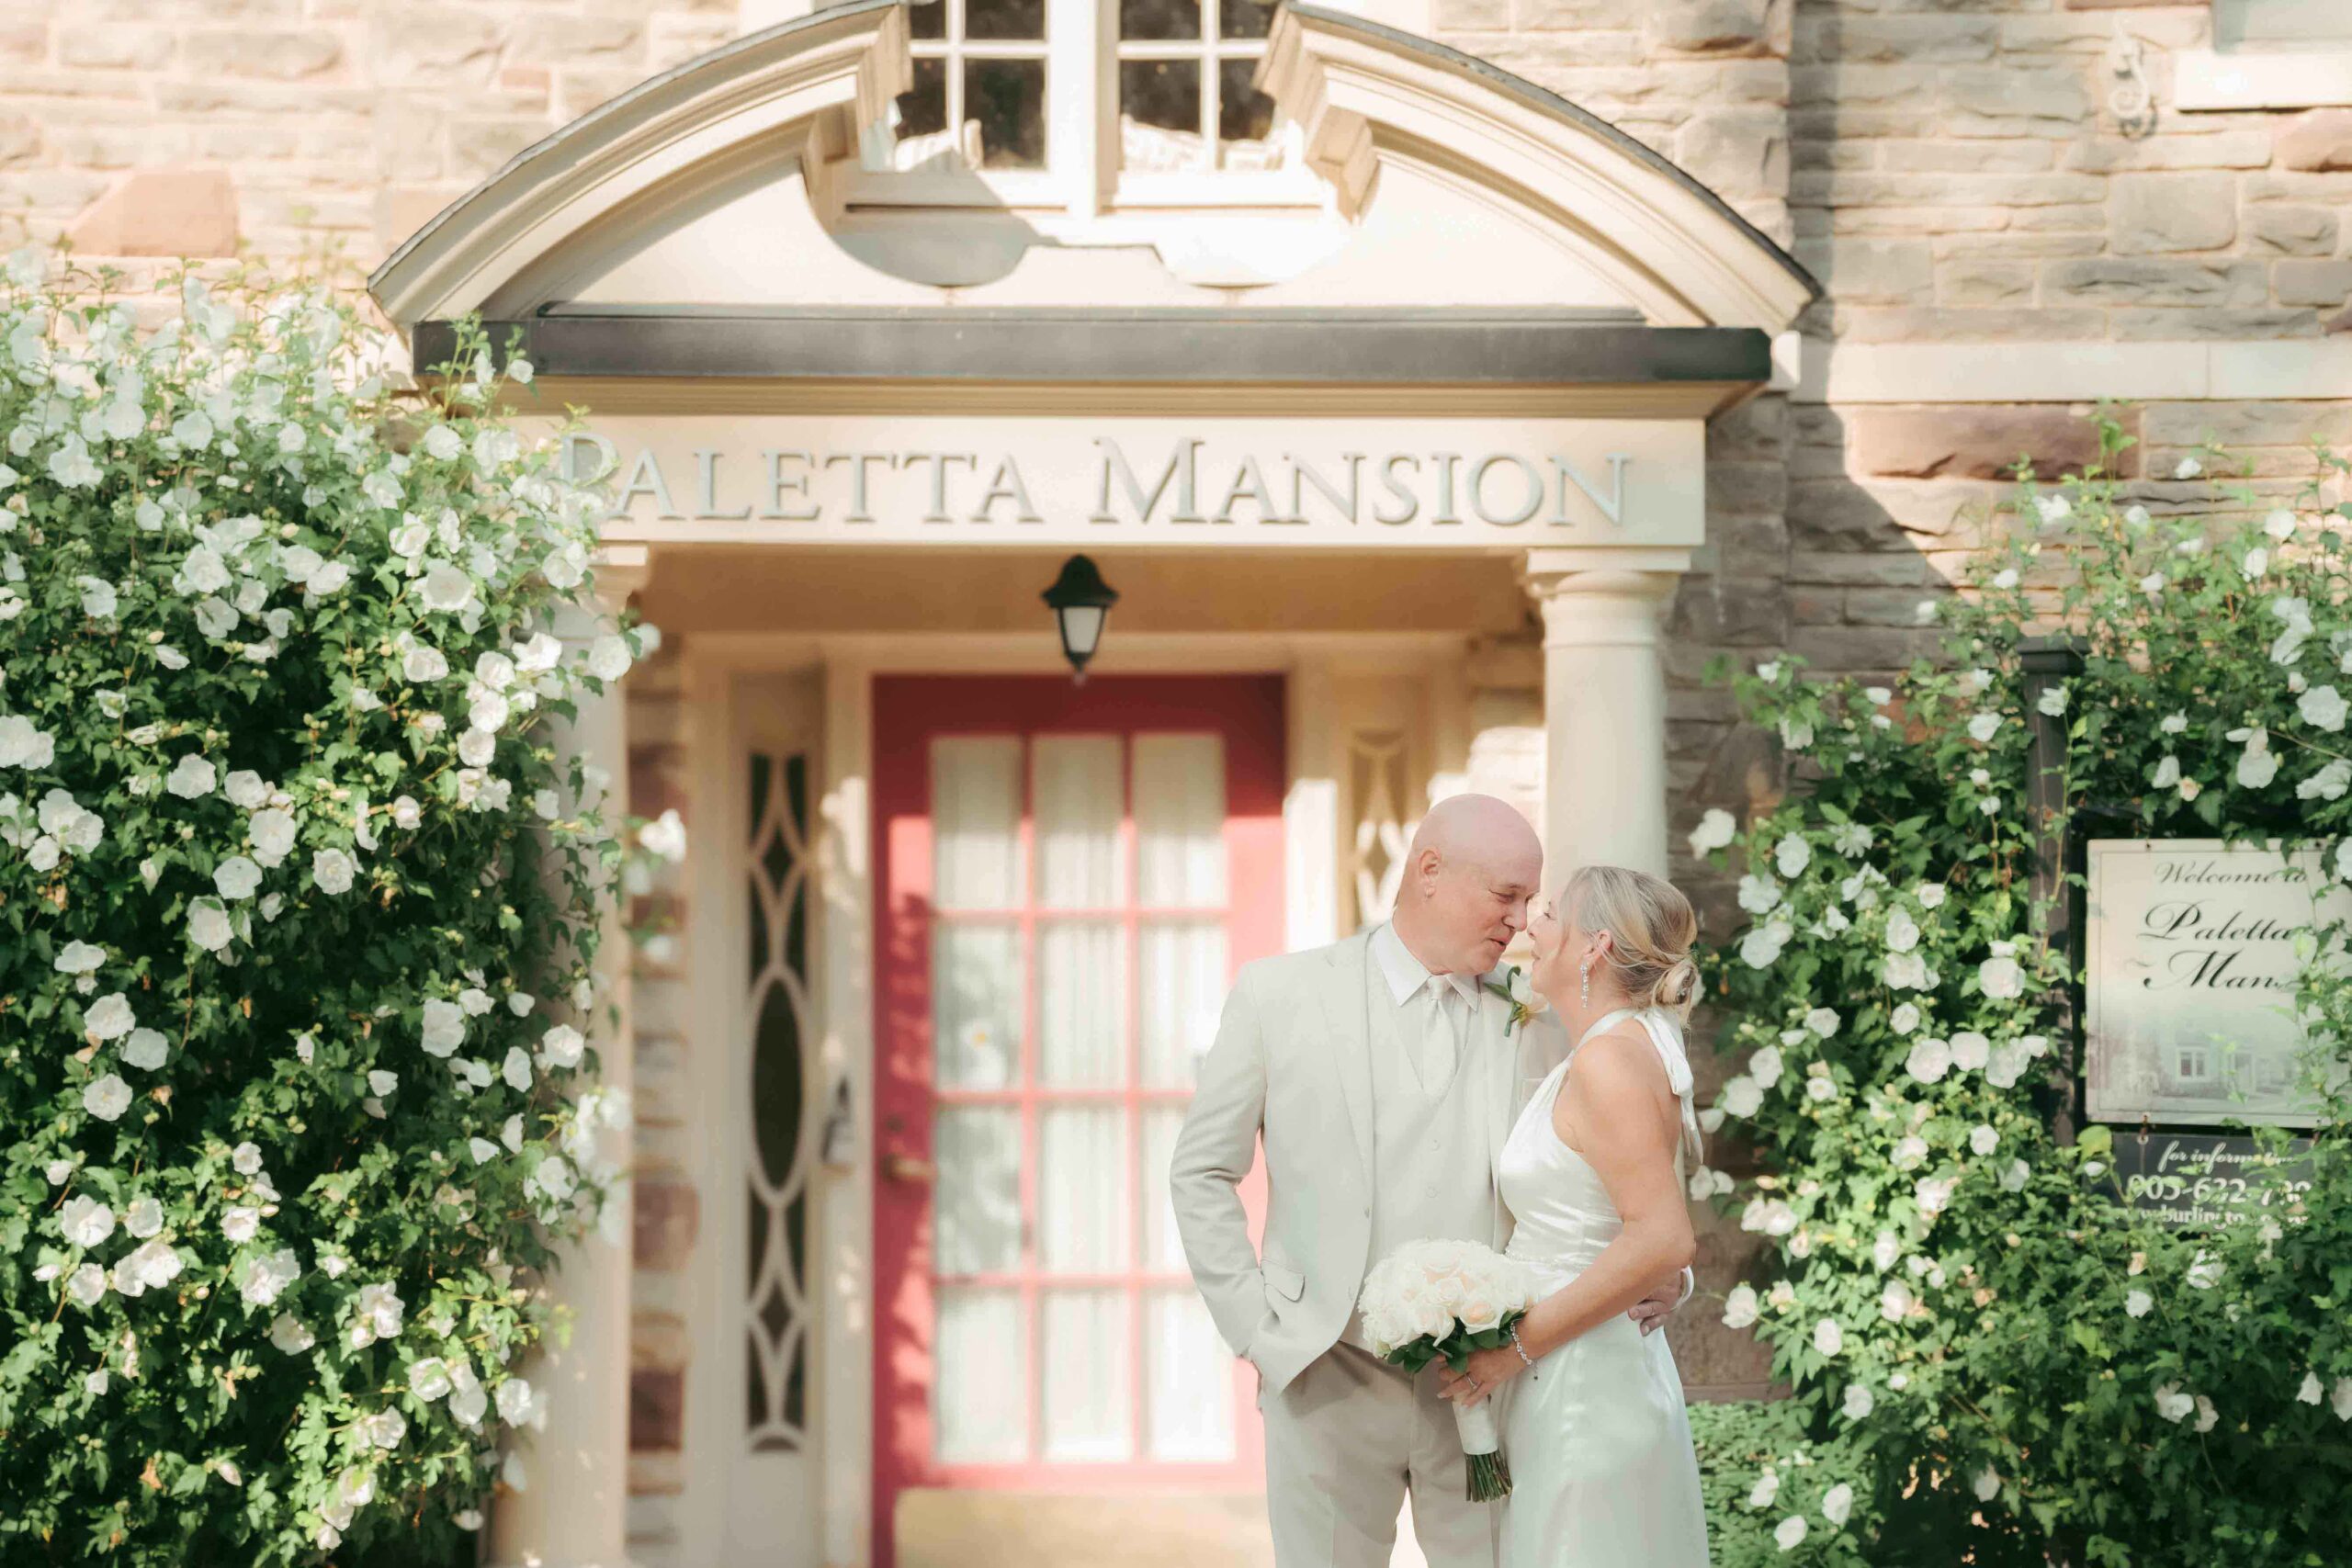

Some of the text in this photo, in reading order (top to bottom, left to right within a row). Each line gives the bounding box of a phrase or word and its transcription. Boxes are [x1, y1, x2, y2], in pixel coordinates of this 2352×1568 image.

[559, 433, 1634, 527] PALETTA MANSION
[2155, 861, 2278, 884] Welcome
[2137, 898, 2293, 942] Paletta
[2157, 1140, 2188, 1173] for
